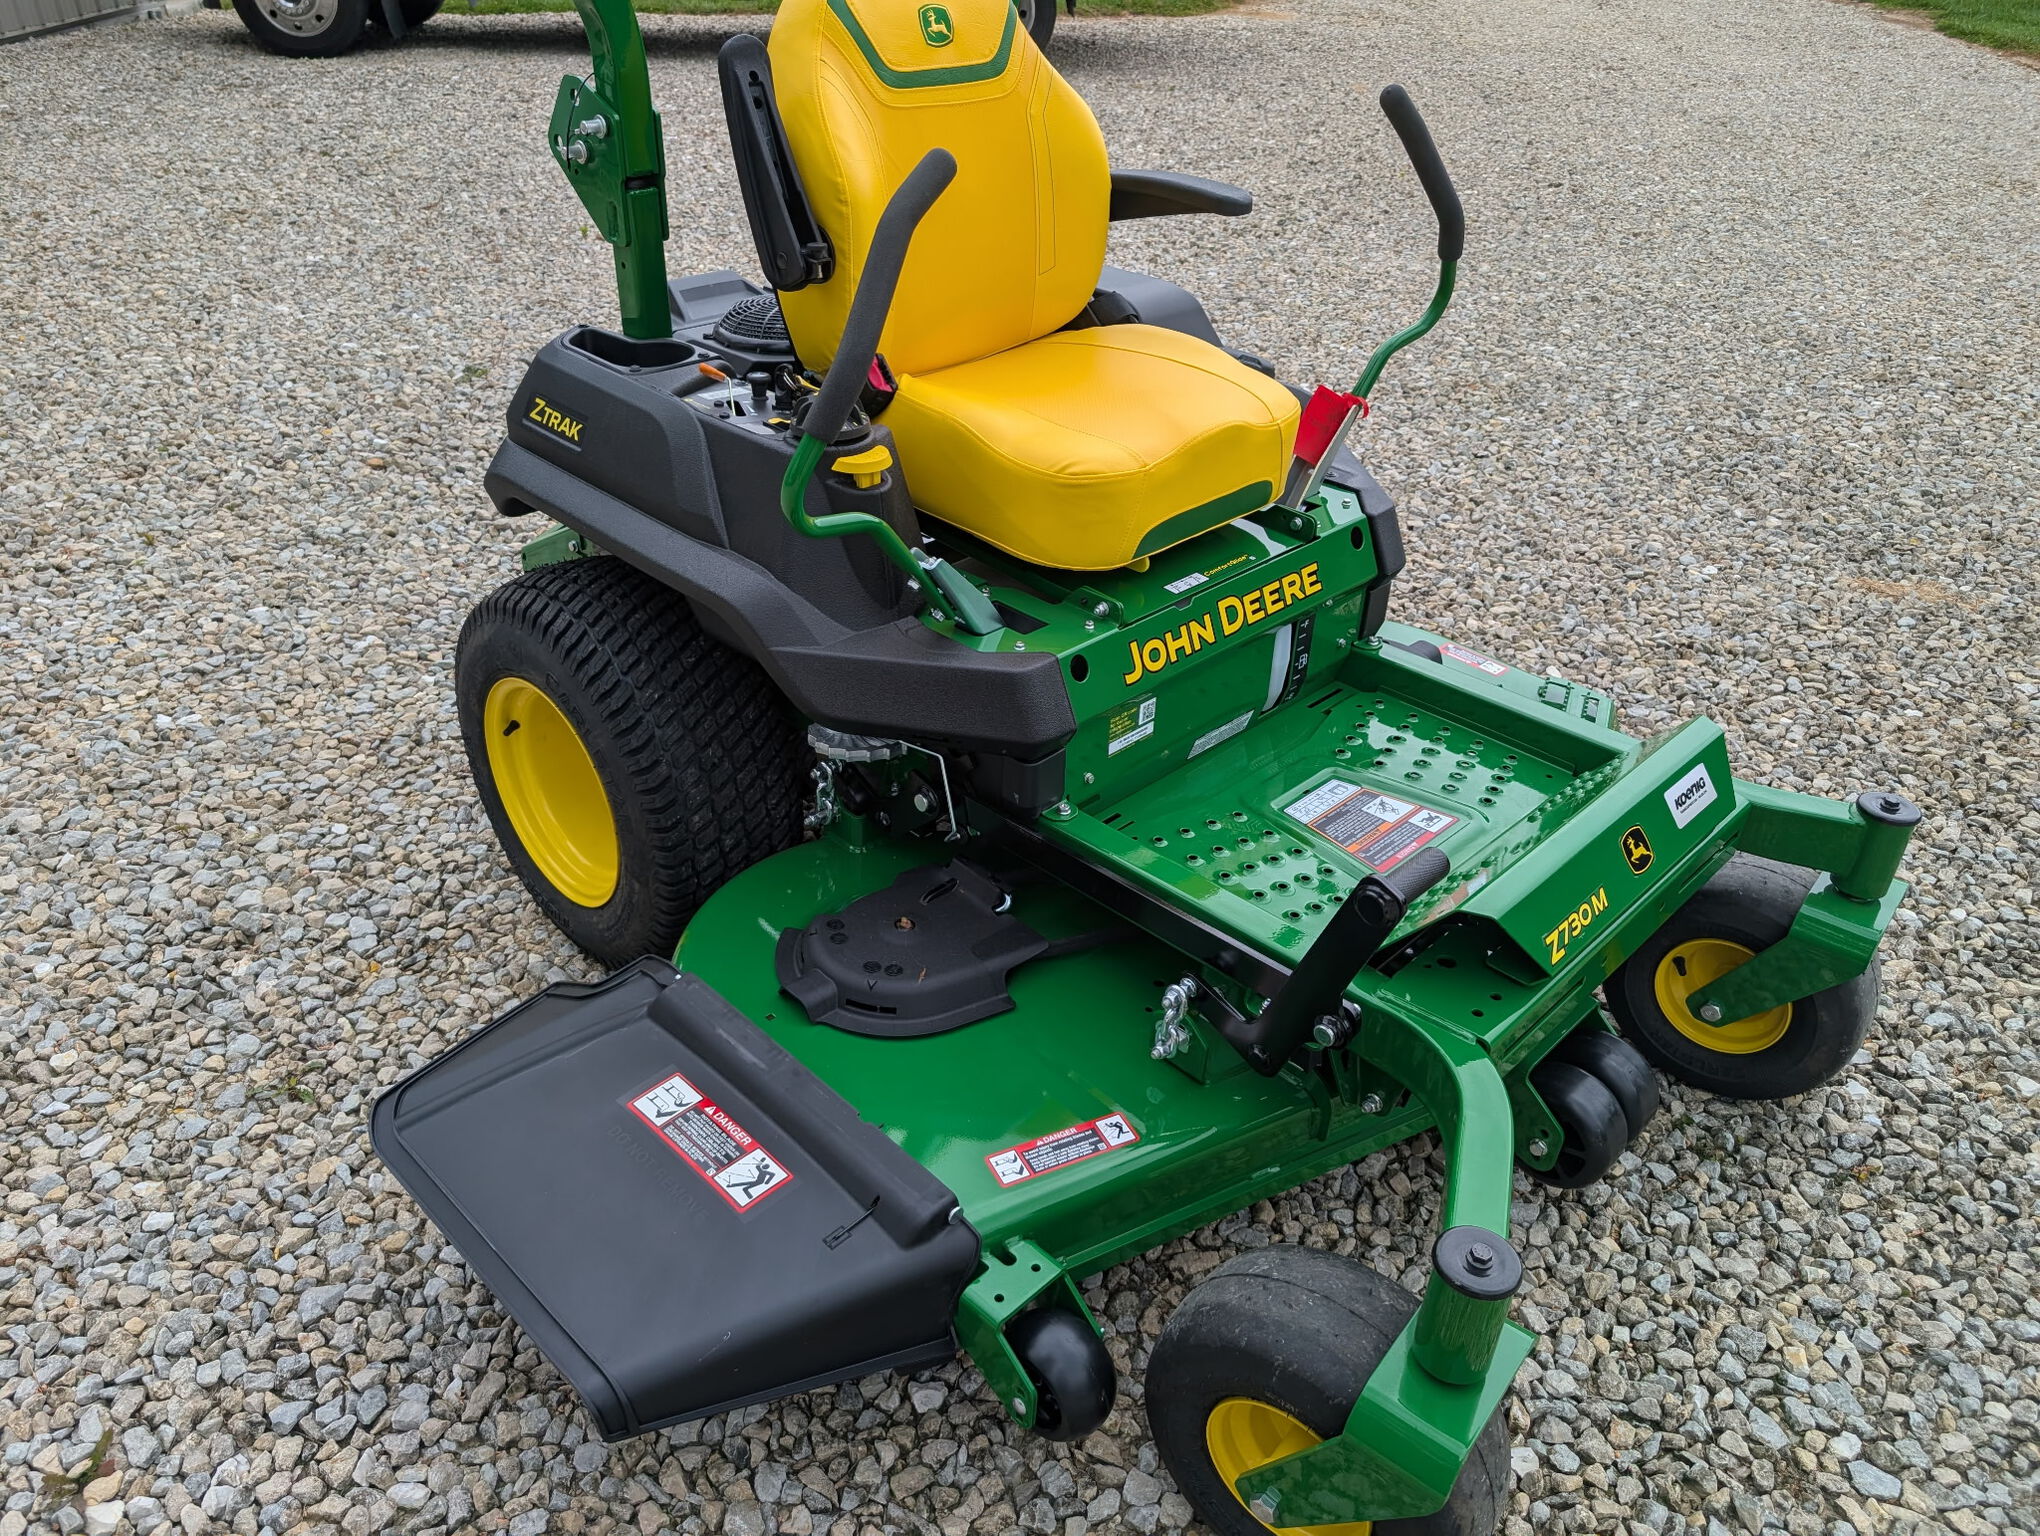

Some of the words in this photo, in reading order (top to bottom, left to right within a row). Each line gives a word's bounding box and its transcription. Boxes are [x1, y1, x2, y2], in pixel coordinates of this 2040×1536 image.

[529, 397, 584, 441] ZTRAK
[1124, 613, 1216, 686] JOHN
[1216, 561, 1323, 639] DEERE
[713, 1111, 752, 1146] DANGER
[1043, 1127, 1078, 1143] DANGER
